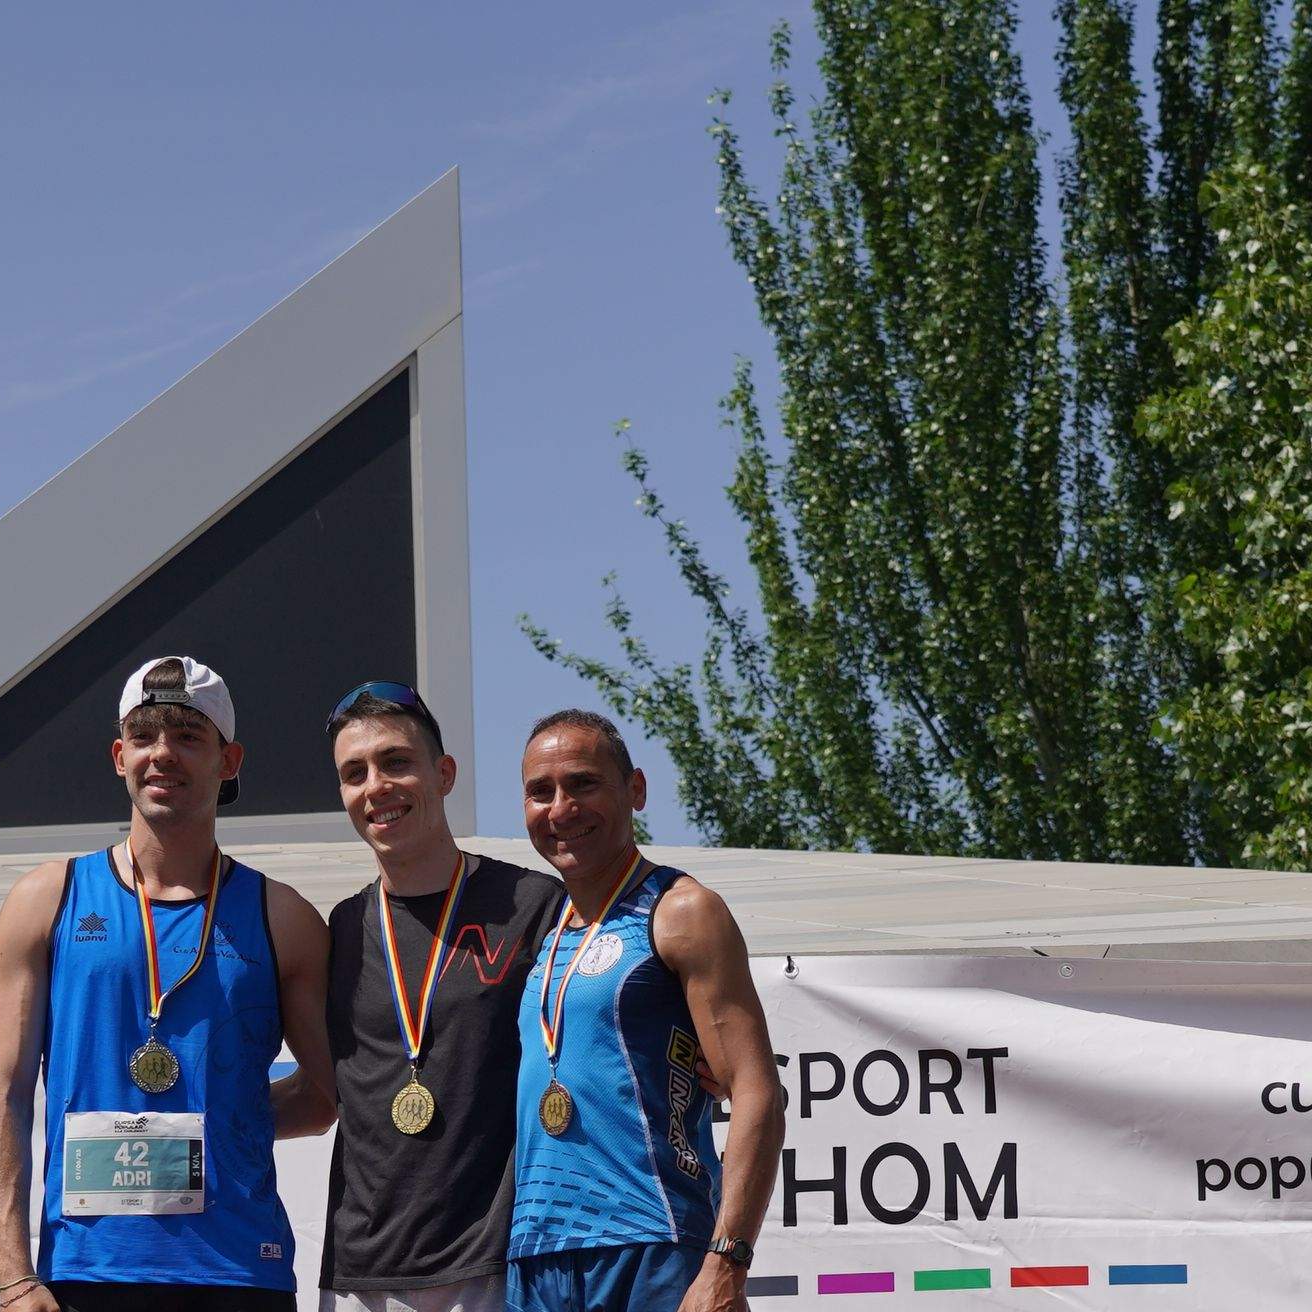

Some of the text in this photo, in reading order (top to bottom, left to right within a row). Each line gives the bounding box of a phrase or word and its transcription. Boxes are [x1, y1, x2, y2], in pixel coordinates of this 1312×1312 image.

[712, 1047, 1008, 1122] PORT
[112, 1170, 152, 1187] ADRI
[114, 1141, 149, 1167] 42
[721, 1142, 1019, 1227] HOM
